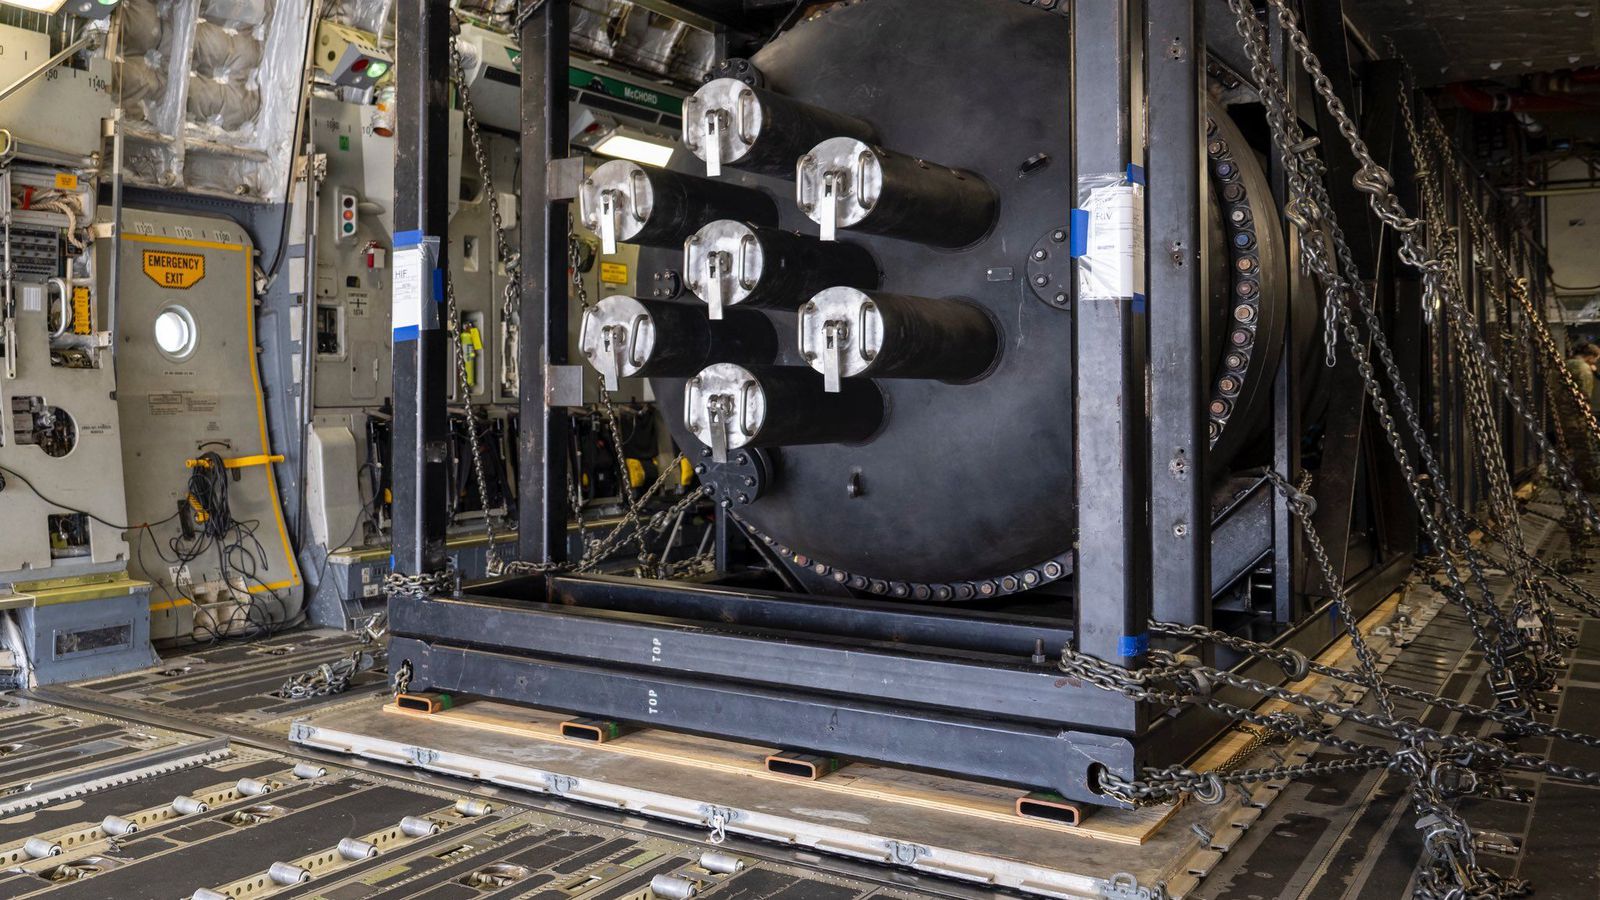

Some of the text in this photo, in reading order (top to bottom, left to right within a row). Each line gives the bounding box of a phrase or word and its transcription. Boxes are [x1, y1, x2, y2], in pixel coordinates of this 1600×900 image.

[88, 77, 105, 89] 1140
[624, 87, 658, 104] McCHORD
[148, 255, 199, 270] EMERGENCY
[165, 272, 184, 284] EXIT
[652, 638, 661, 662] TOP
[648, 690, 658, 714] TOP
